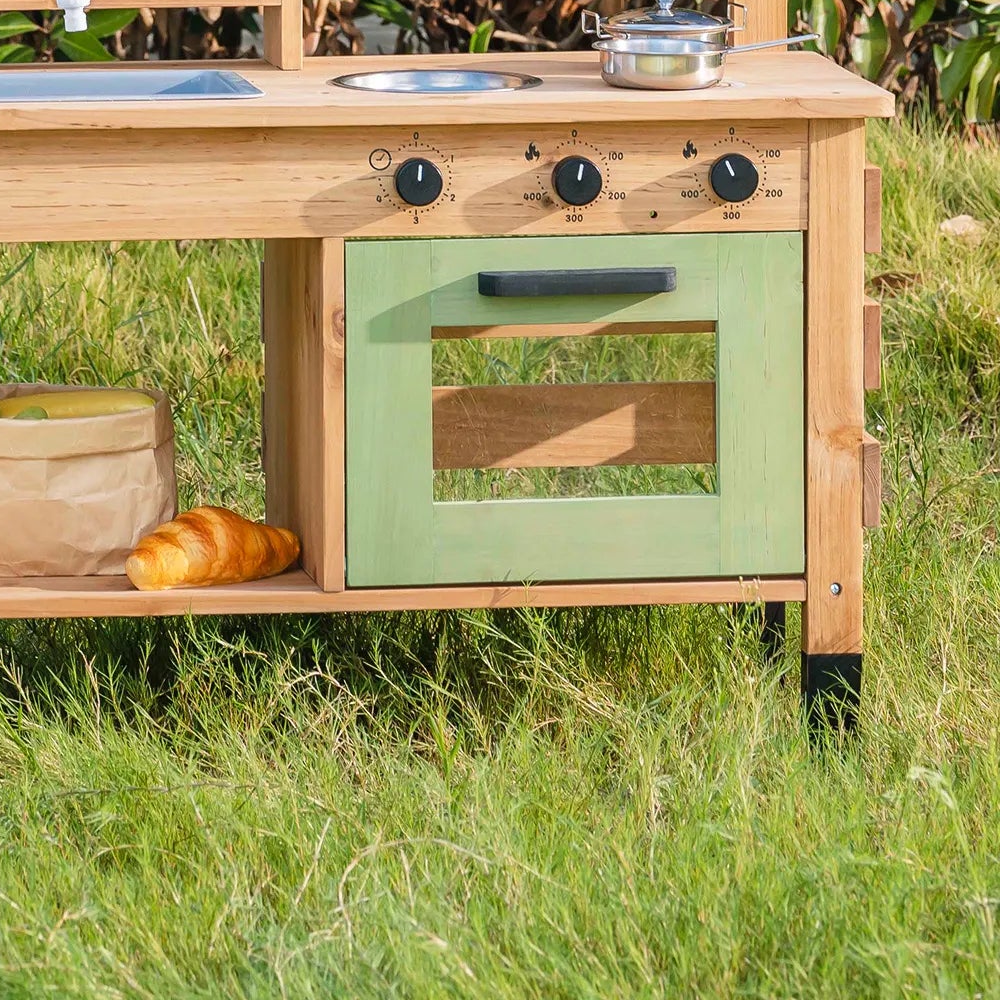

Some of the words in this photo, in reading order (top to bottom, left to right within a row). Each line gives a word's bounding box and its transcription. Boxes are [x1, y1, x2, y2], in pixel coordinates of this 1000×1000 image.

[571, 129, 578, 138] 0
[729, 127, 735, 135] 0
[413, 132, 419, 140] 0
[608, 152, 624, 160] 100
[765, 149, 781, 158] 100
[523, 192, 541, 201] 400
[608, 191, 626, 200] 200
[680, 190, 699, 198] 400
[765, 189, 783, 197] 200
[376, 195, 382, 203] 4
[450, 194, 456, 202] 2
[565, 214, 583, 222] 300
[722, 211, 741, 220] 300
